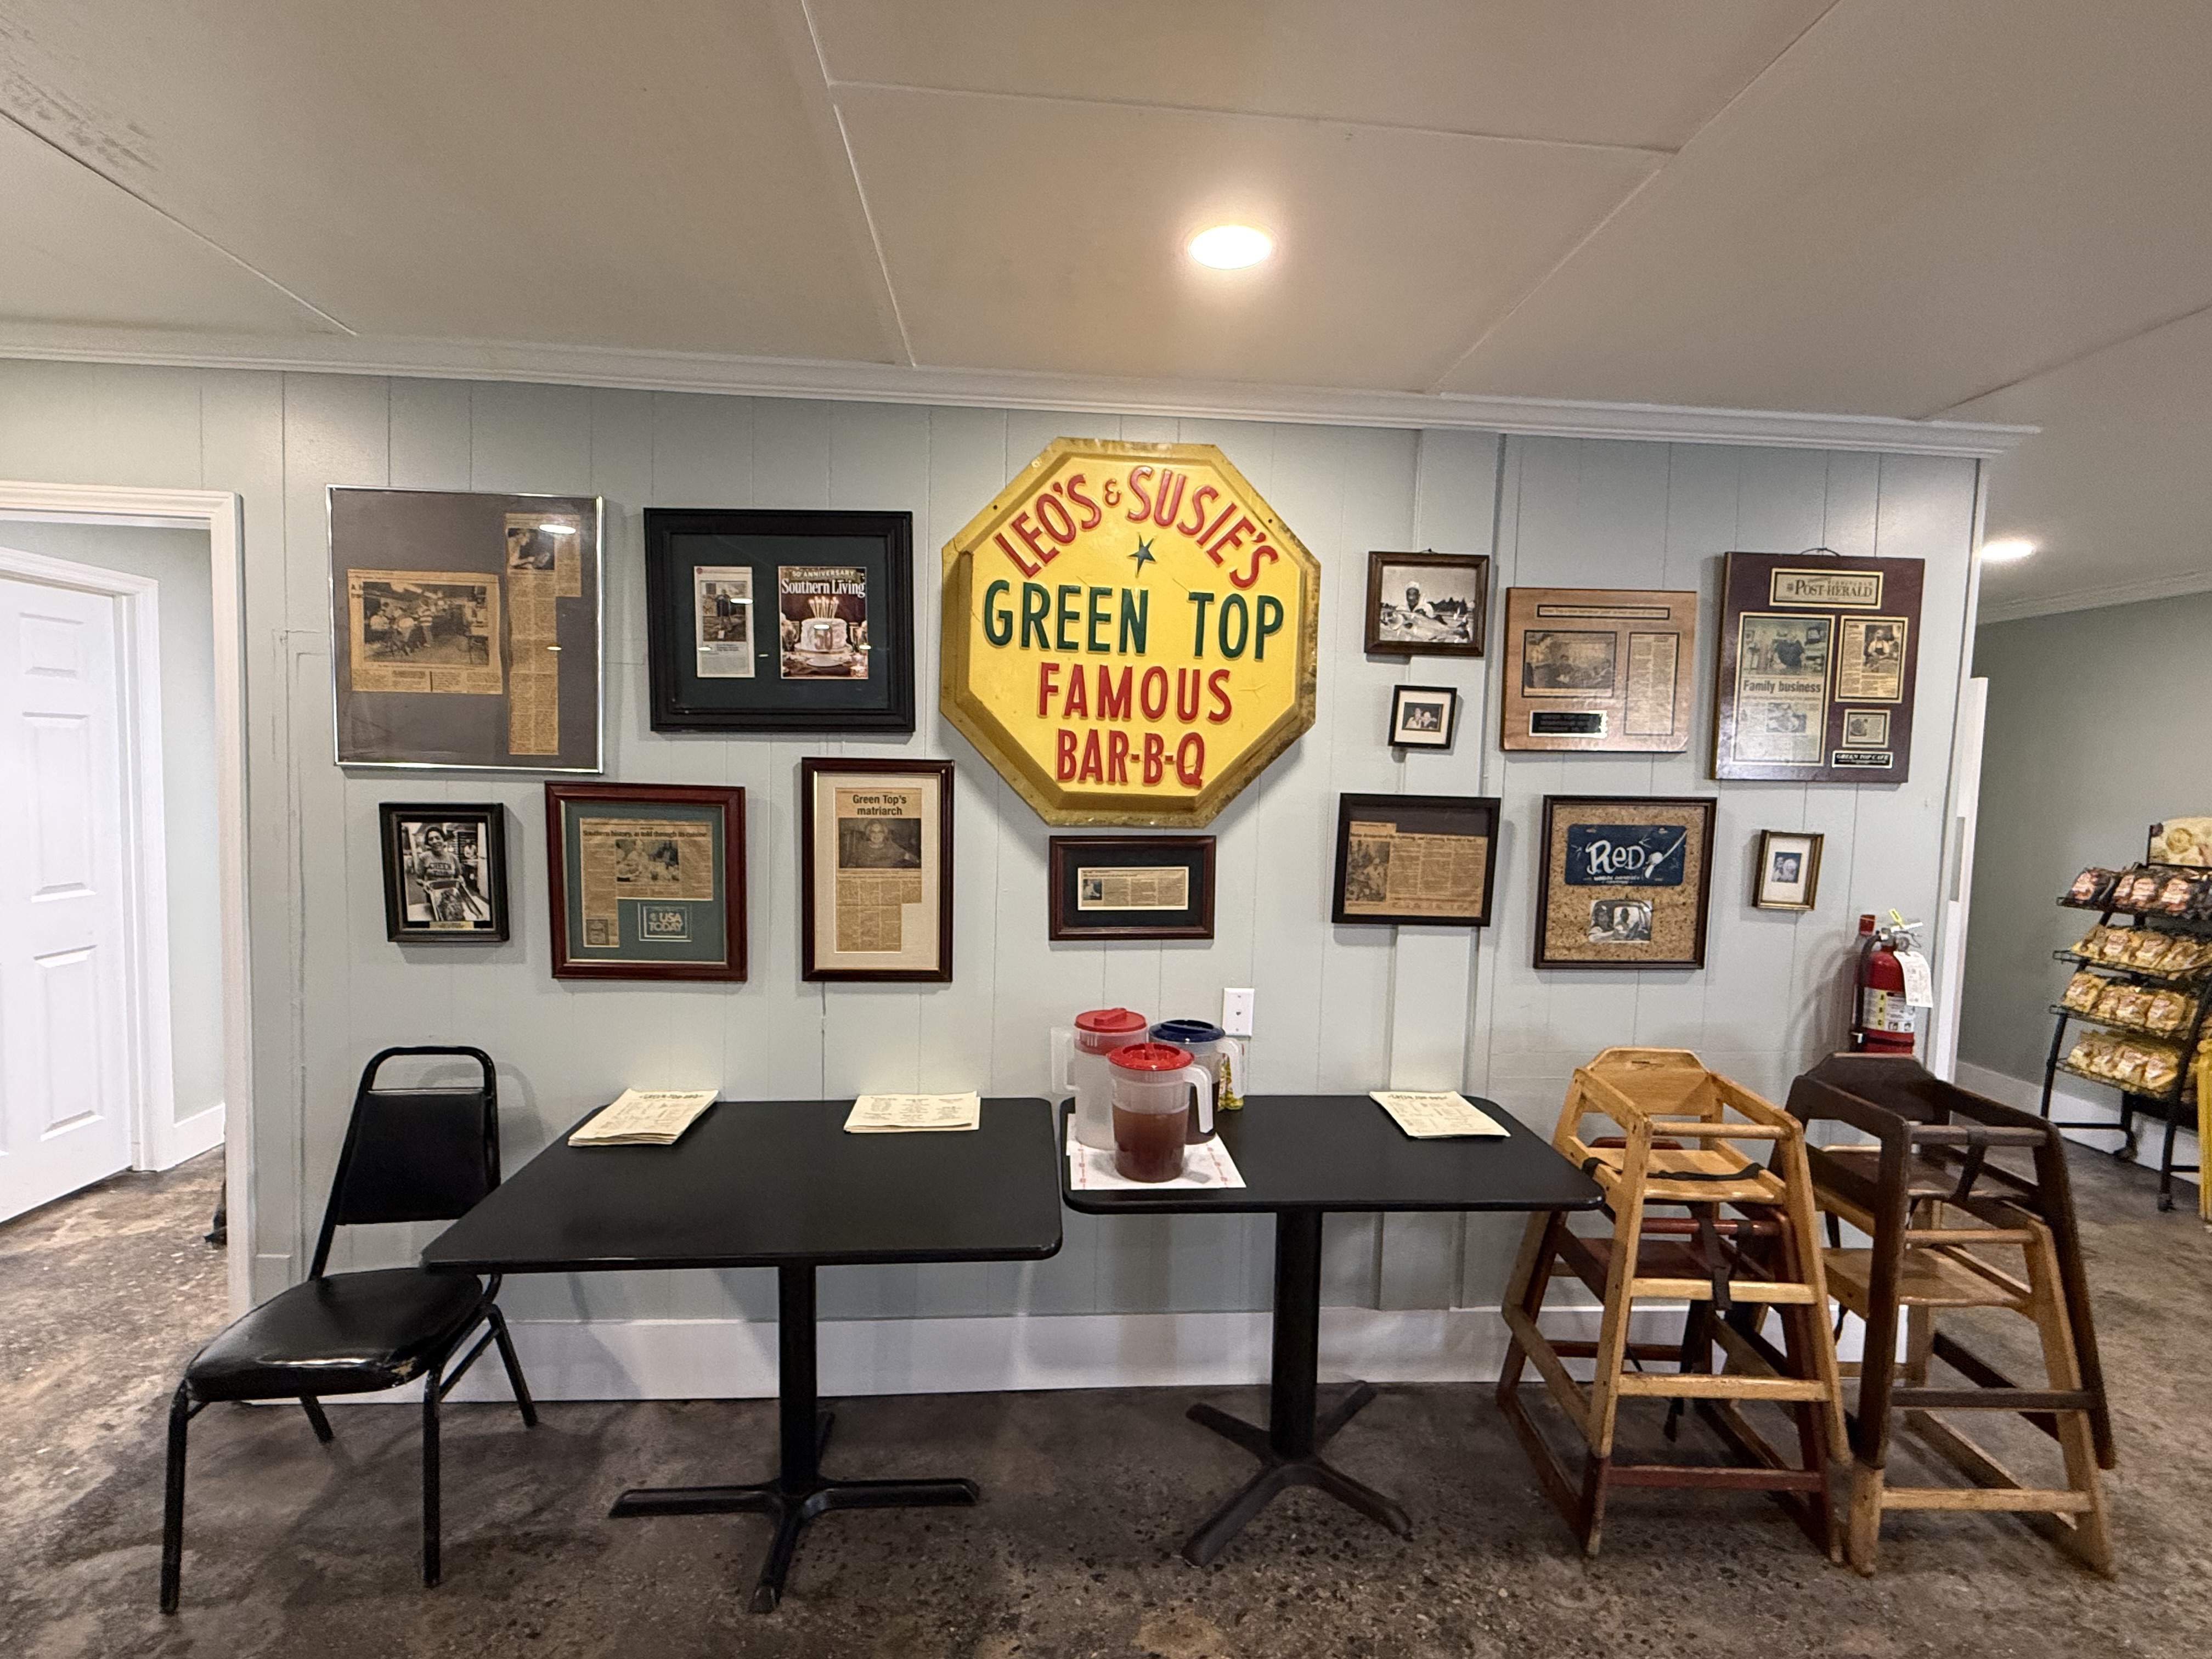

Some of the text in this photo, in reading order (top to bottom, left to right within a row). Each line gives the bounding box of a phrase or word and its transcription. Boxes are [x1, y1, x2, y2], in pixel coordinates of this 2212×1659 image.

[992, 465, 1279, 589] LEO'S & SUSIE'S
[803, 569, 854, 578] ANNIVERSARY
[781, 578, 866, 598] Southern Living
[983, 579, 1284, 662] GREEN TOP
[1037, 662, 1232, 723] FAMOUS
[1743, 680, 1821, 694] Family business
[1055, 727, 1205, 788] BAR-B-Q
[853, 794, 907, 806] Green Top's
[857, 806, 902, 815] matriarch
[658, 912, 682, 923] USA
[648, 922, 684, 932] TODAY
